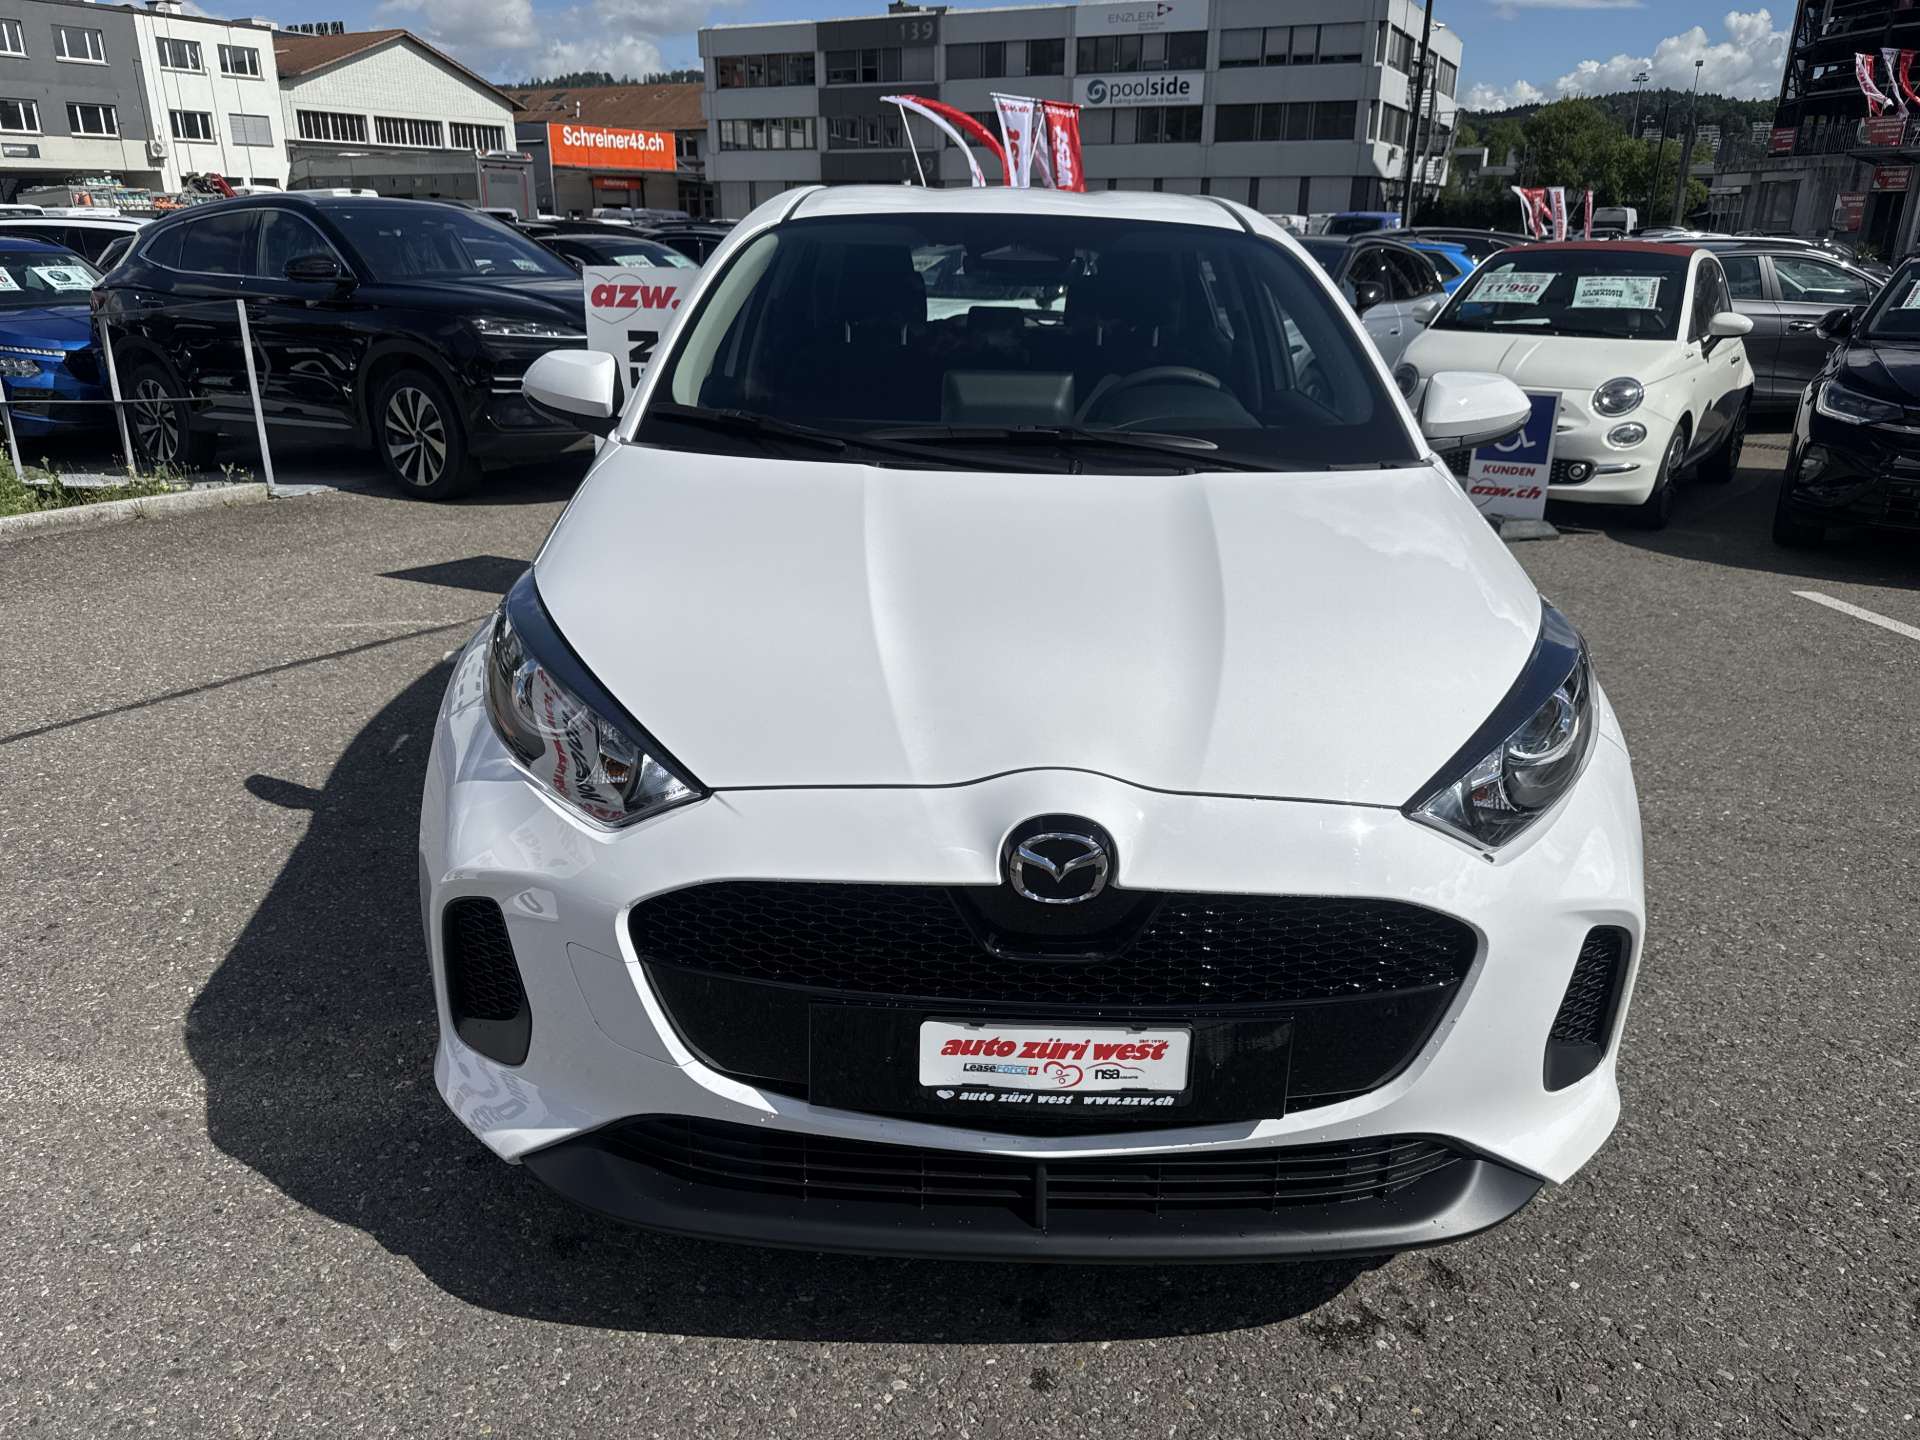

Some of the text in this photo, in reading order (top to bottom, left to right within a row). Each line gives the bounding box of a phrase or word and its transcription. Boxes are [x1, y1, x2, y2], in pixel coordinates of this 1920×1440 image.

[1107, 11, 1155, 24] ENZLER
[900, 21, 934, 40] 139
[1110, 76, 1190, 104] poolside
[563, 125, 665, 152] Schreiner48.ch
[1486, 282, 1541, 294] 11'950
[1482, 464, 1536, 477] KUNDEN
[941, 1036, 1169, 1060] auto züri west
[1095, 1069, 1120, 1079] nsa
[959, 1091, 1175, 1106] auto züri west www.azw.ch
